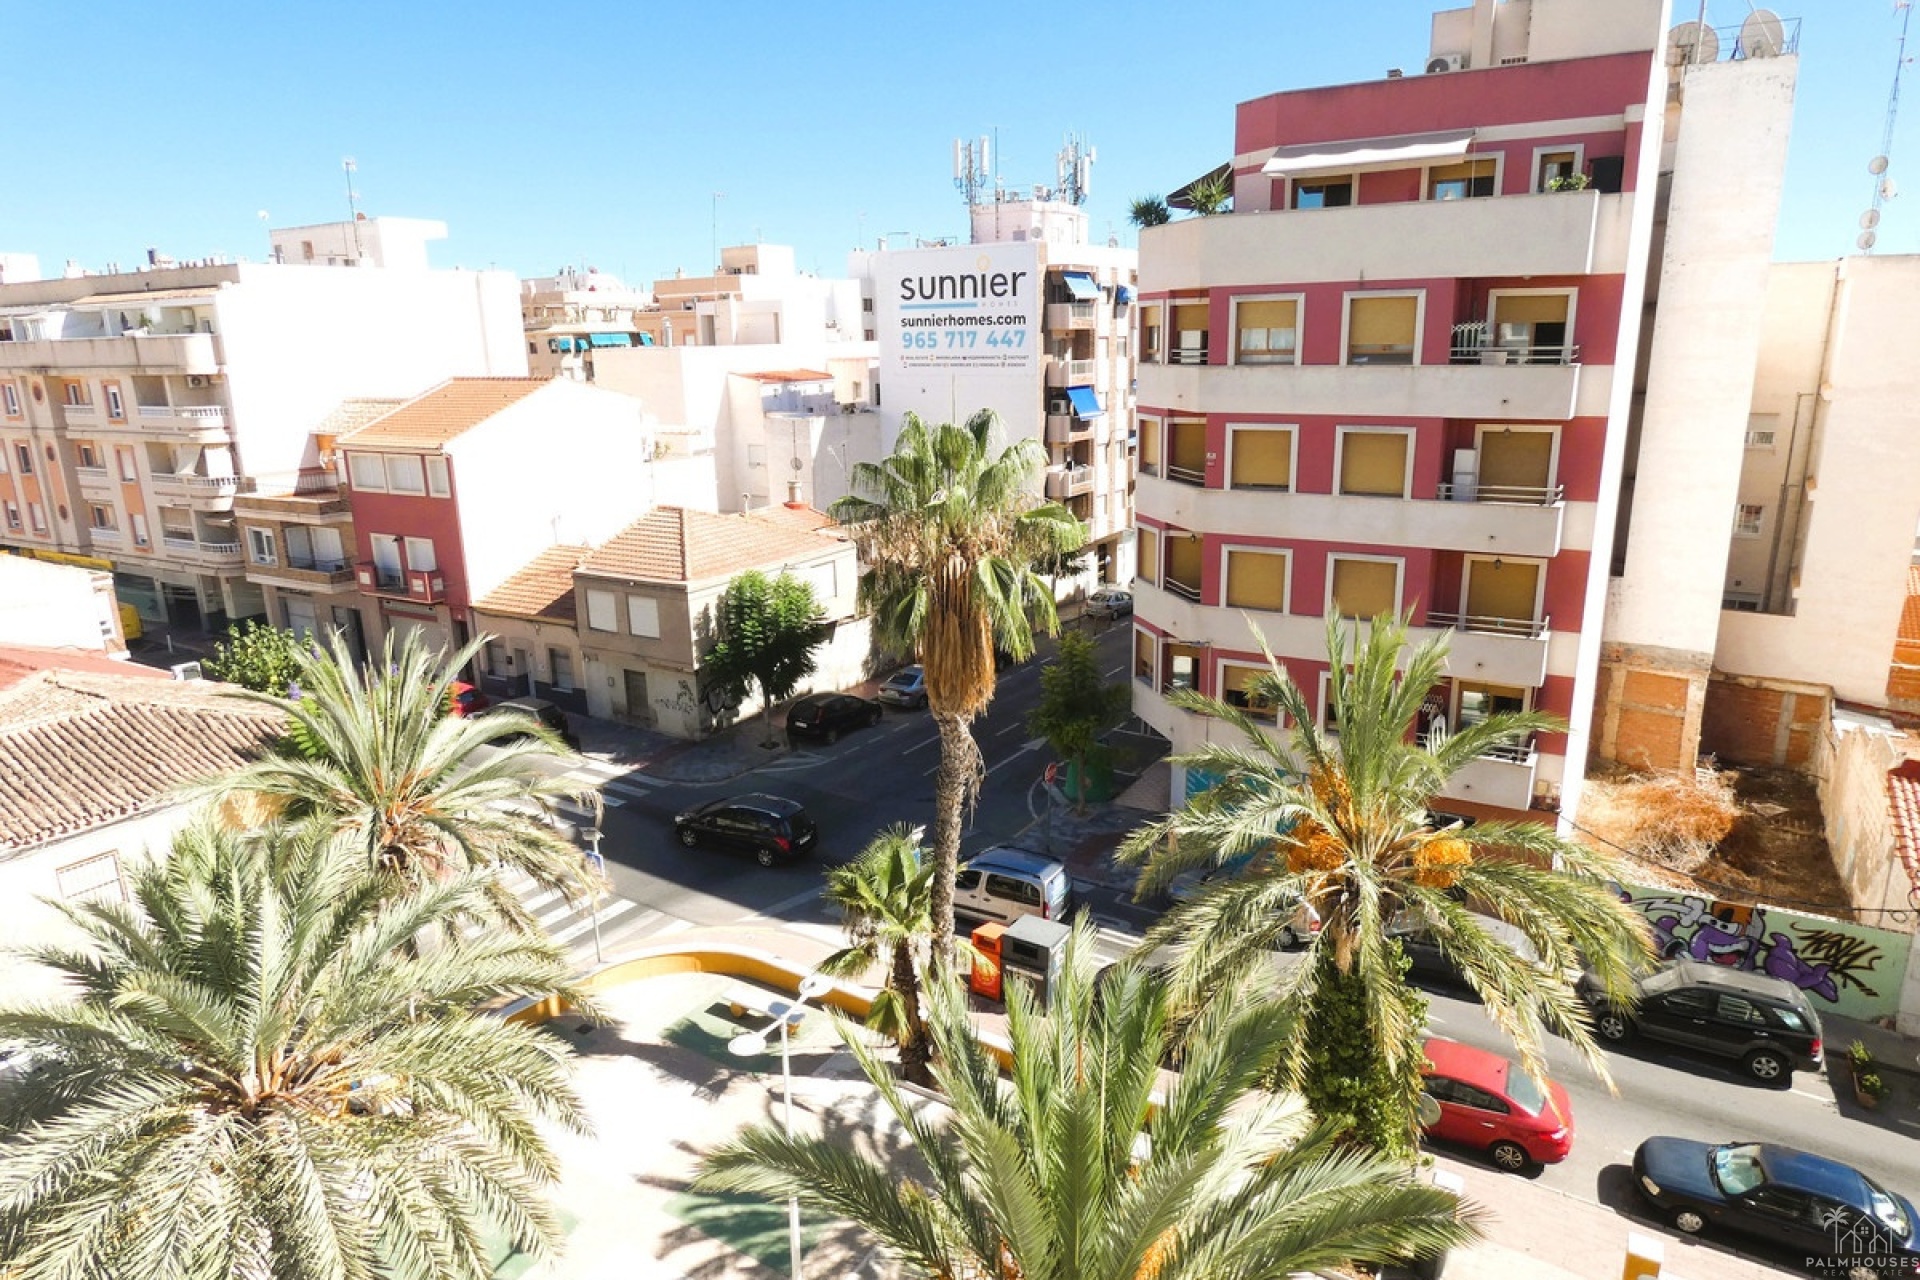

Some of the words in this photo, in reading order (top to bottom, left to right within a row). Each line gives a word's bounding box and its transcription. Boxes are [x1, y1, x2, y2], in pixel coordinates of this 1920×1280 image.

[900, 270, 1028, 301] sunnier
[900, 313, 1027, 328] sunnierhomes.com
[902, 331, 938, 350] 965
[945, 330, 978, 349] 717
[985, 329, 1027, 349] 447
